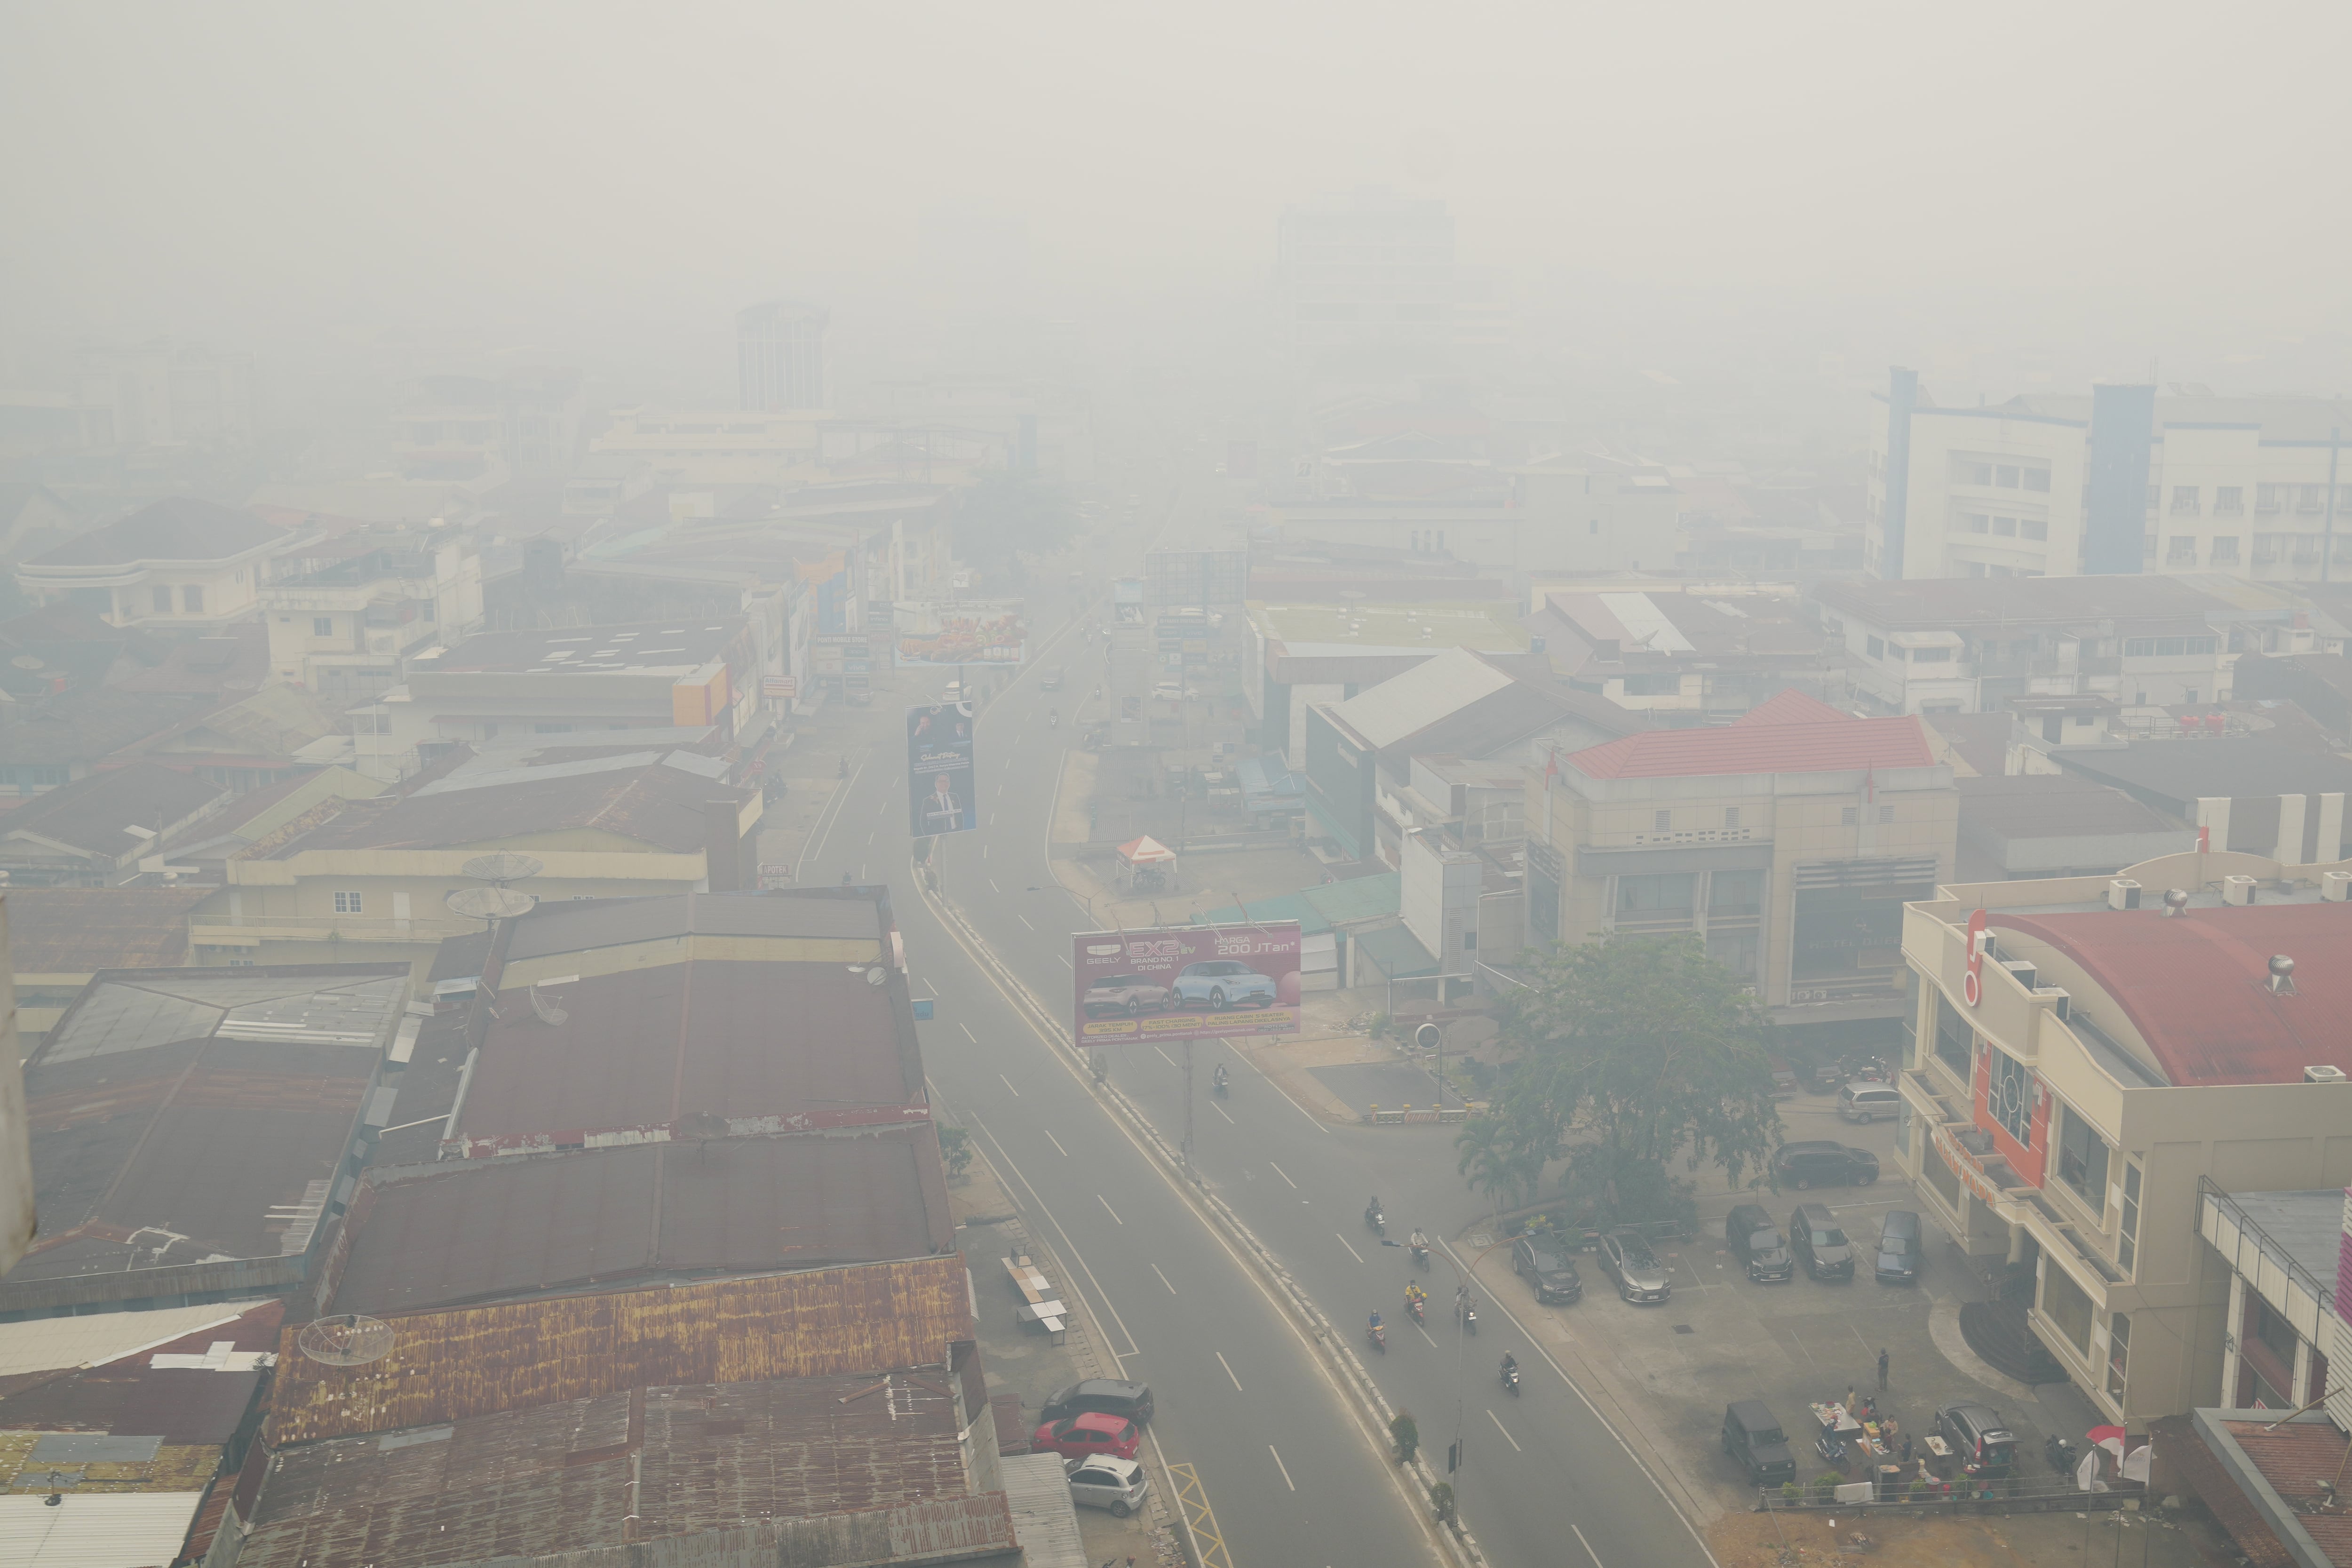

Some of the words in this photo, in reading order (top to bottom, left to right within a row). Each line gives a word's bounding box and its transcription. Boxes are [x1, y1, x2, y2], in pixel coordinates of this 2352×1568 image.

[763, 865, 787, 874] APOTEK
[1215, 936, 1250, 945] HARGA
[1809, 939, 1855, 949] HOTEL
[1129, 940, 1179, 957] EX2
[1218, 944, 1250, 955] 200
